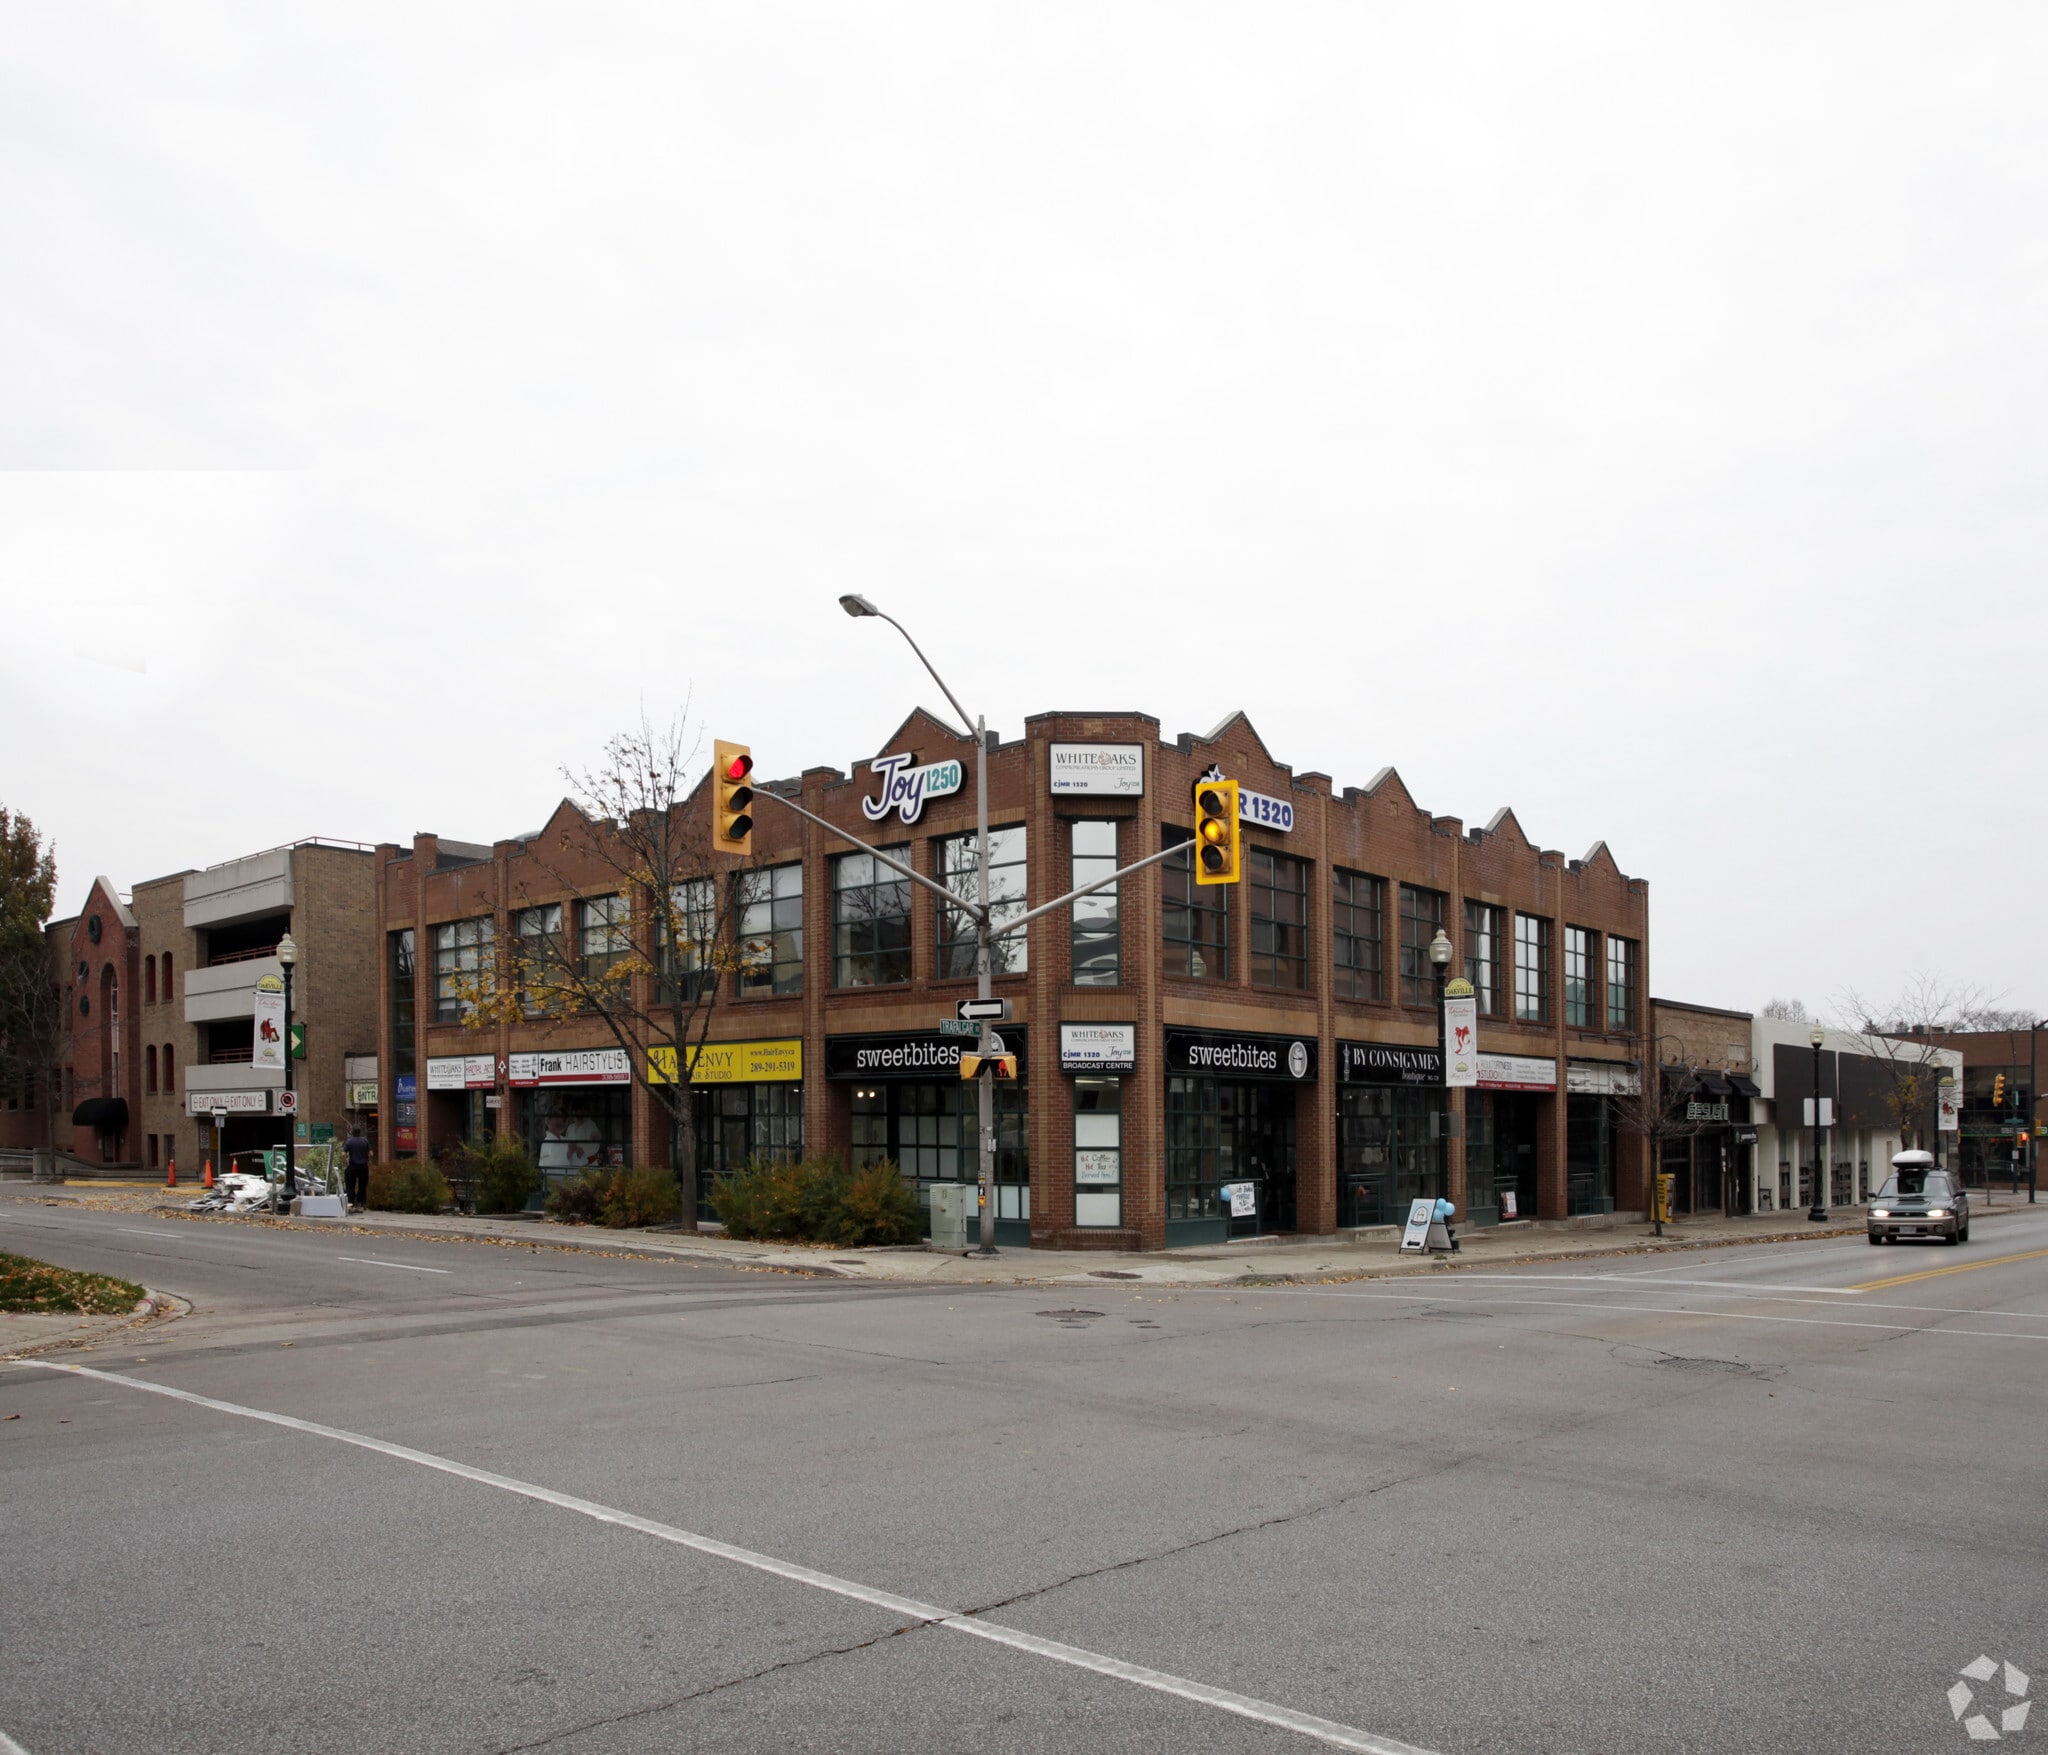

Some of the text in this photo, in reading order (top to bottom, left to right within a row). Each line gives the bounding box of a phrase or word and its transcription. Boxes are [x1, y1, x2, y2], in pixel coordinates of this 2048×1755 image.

[865, 757, 959, 820] Joy 1250
[1114, 777, 1130, 791] Joy
[1252, 796, 1292, 827] 1320
[1446, 987, 1473, 995] OAKVILLE
[942, 1020, 974, 1034] TRAFALGAR
[697, 1048, 733, 1068] ENVY
[857, 1042, 960, 1068] sweetbites
[1105, 1046, 1122, 1060] Joy
[1189, 1043, 1277, 1069] sweetbites
[1353, 1047, 1440, 1070] BY CONSIGNMEN
[541, 1057, 562, 1072] Frank
[751, 1061, 795, 1073] 289-291-5319
[199, 1096, 209, 1108] EXIT
[231, 1095, 256, 1107] EXIT ONLY
[357, 1090, 378, 1101] ENTR
